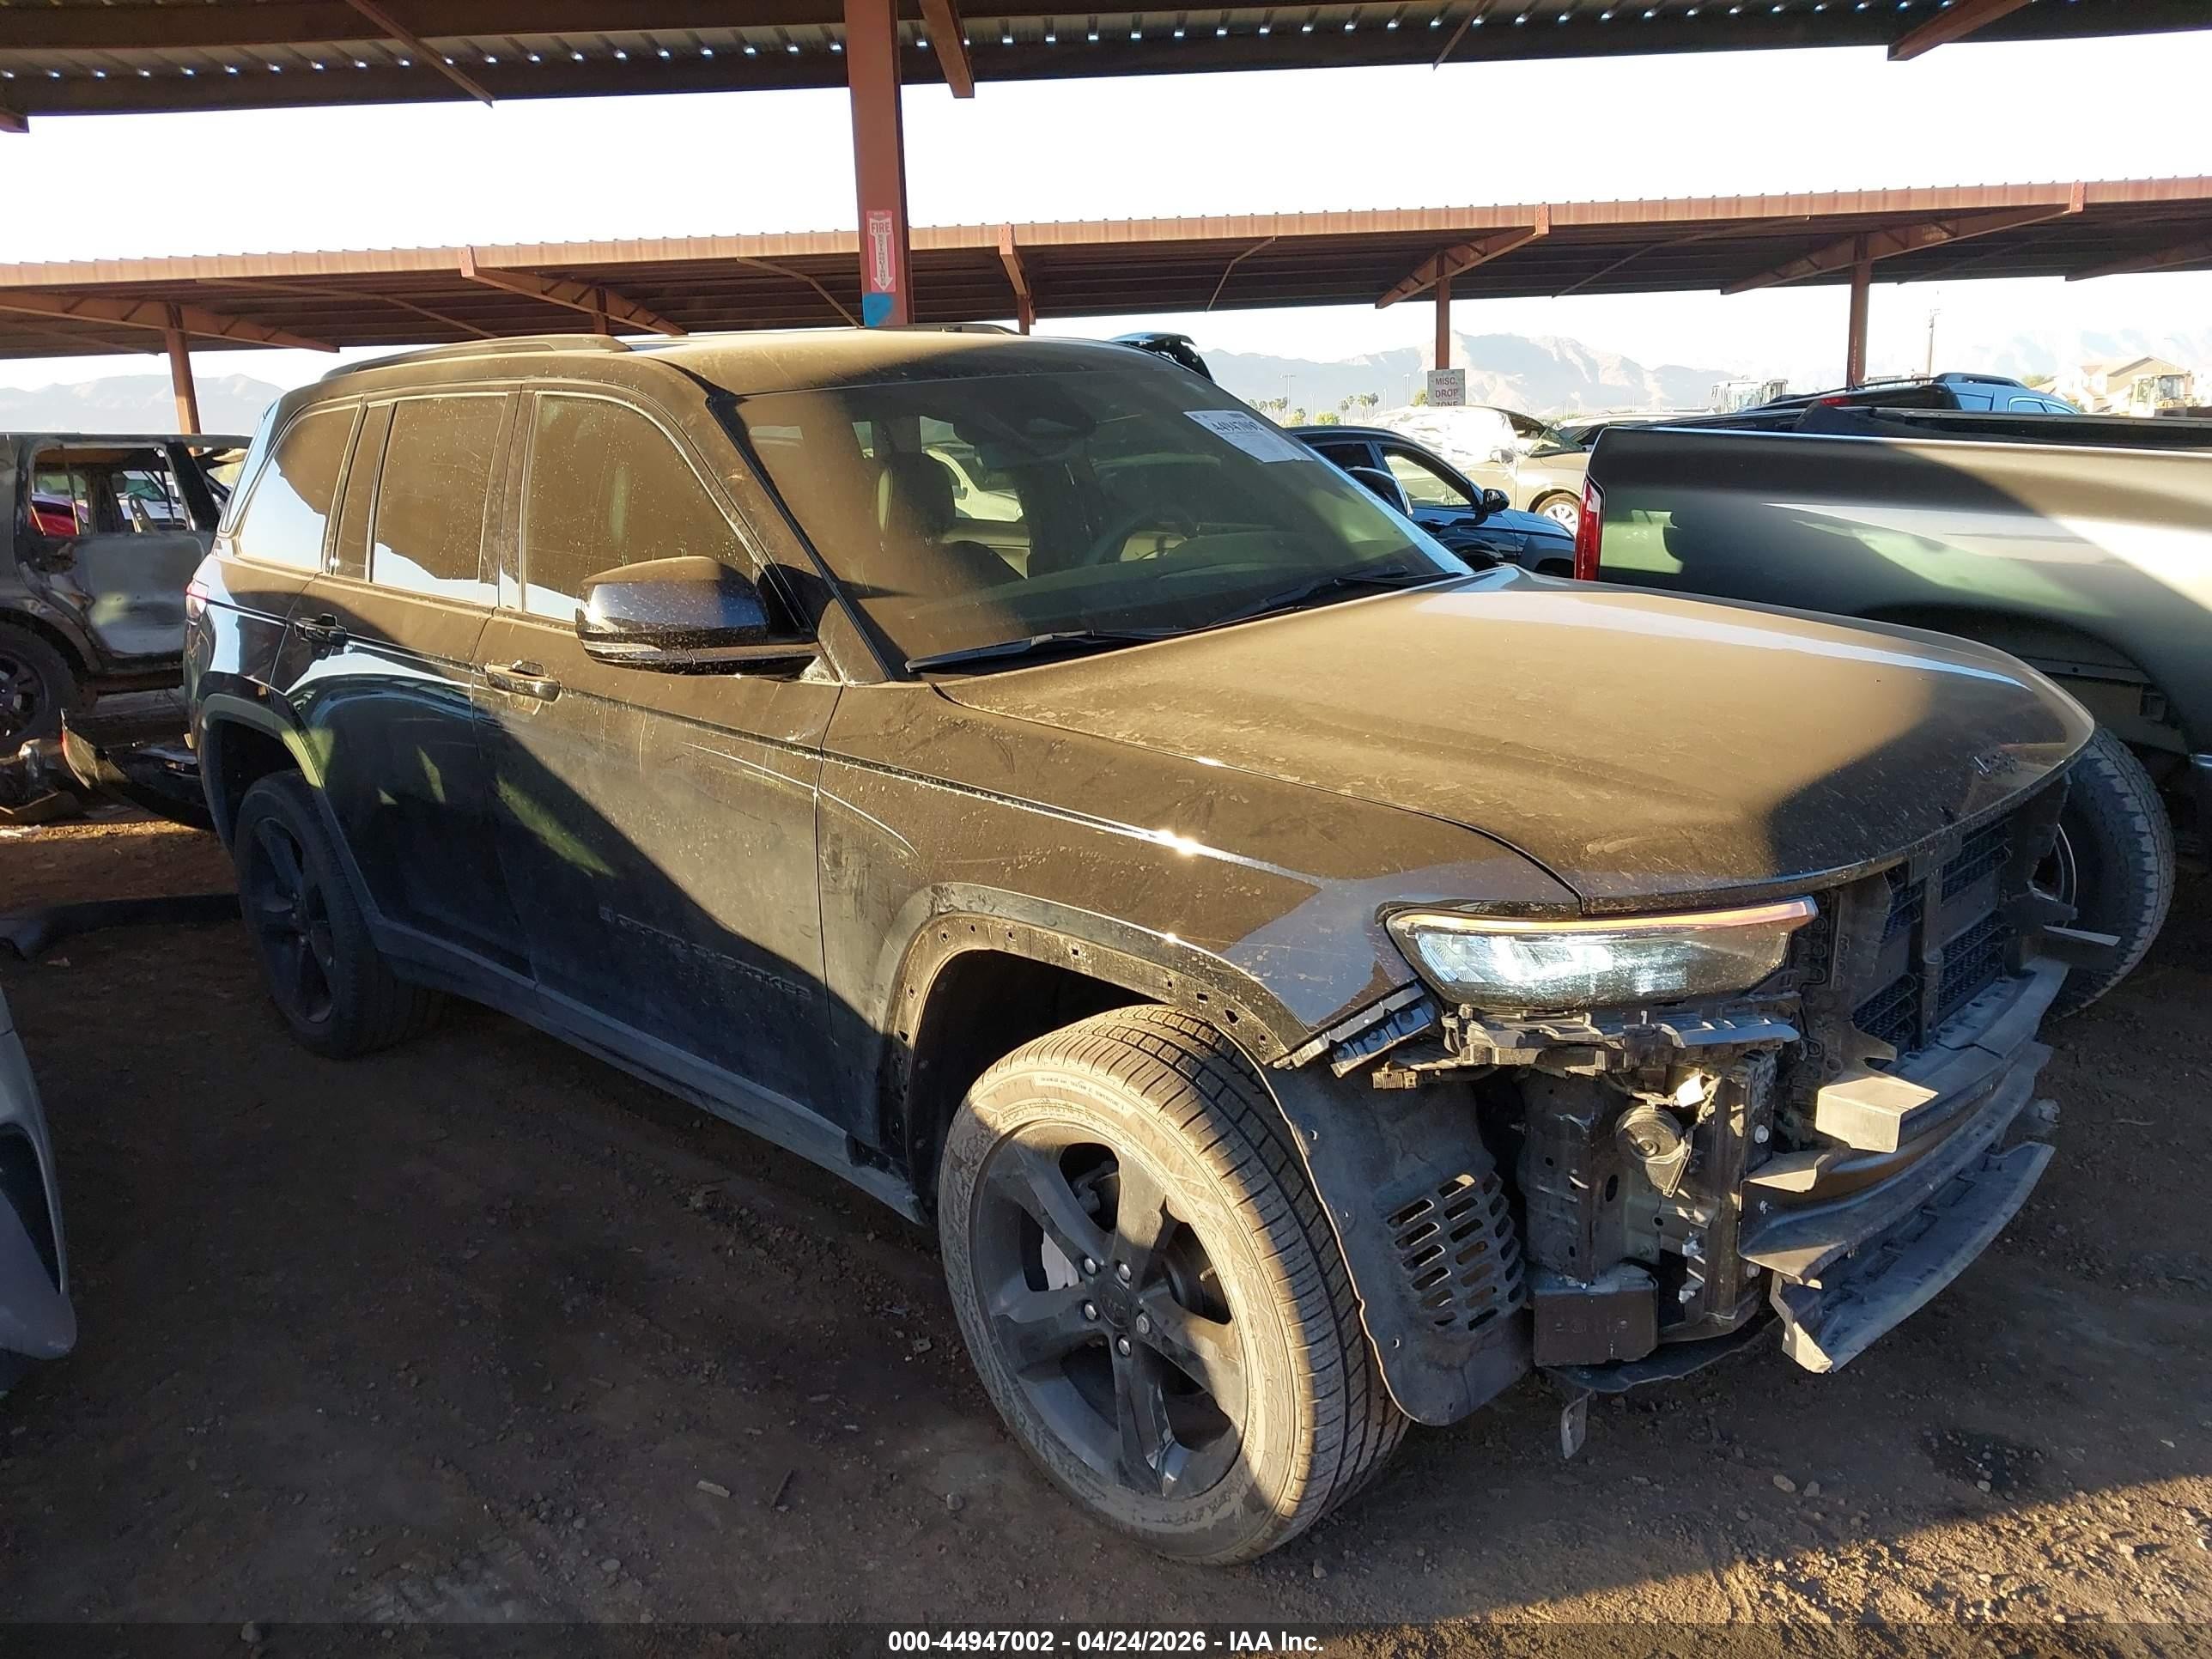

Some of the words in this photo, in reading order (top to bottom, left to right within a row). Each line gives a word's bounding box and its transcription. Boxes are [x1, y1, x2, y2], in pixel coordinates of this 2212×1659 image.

[871, 222, 890, 233] FIRE
[1435, 377, 1458, 386] MISC.
[1435, 388, 1458, 398] DROP
